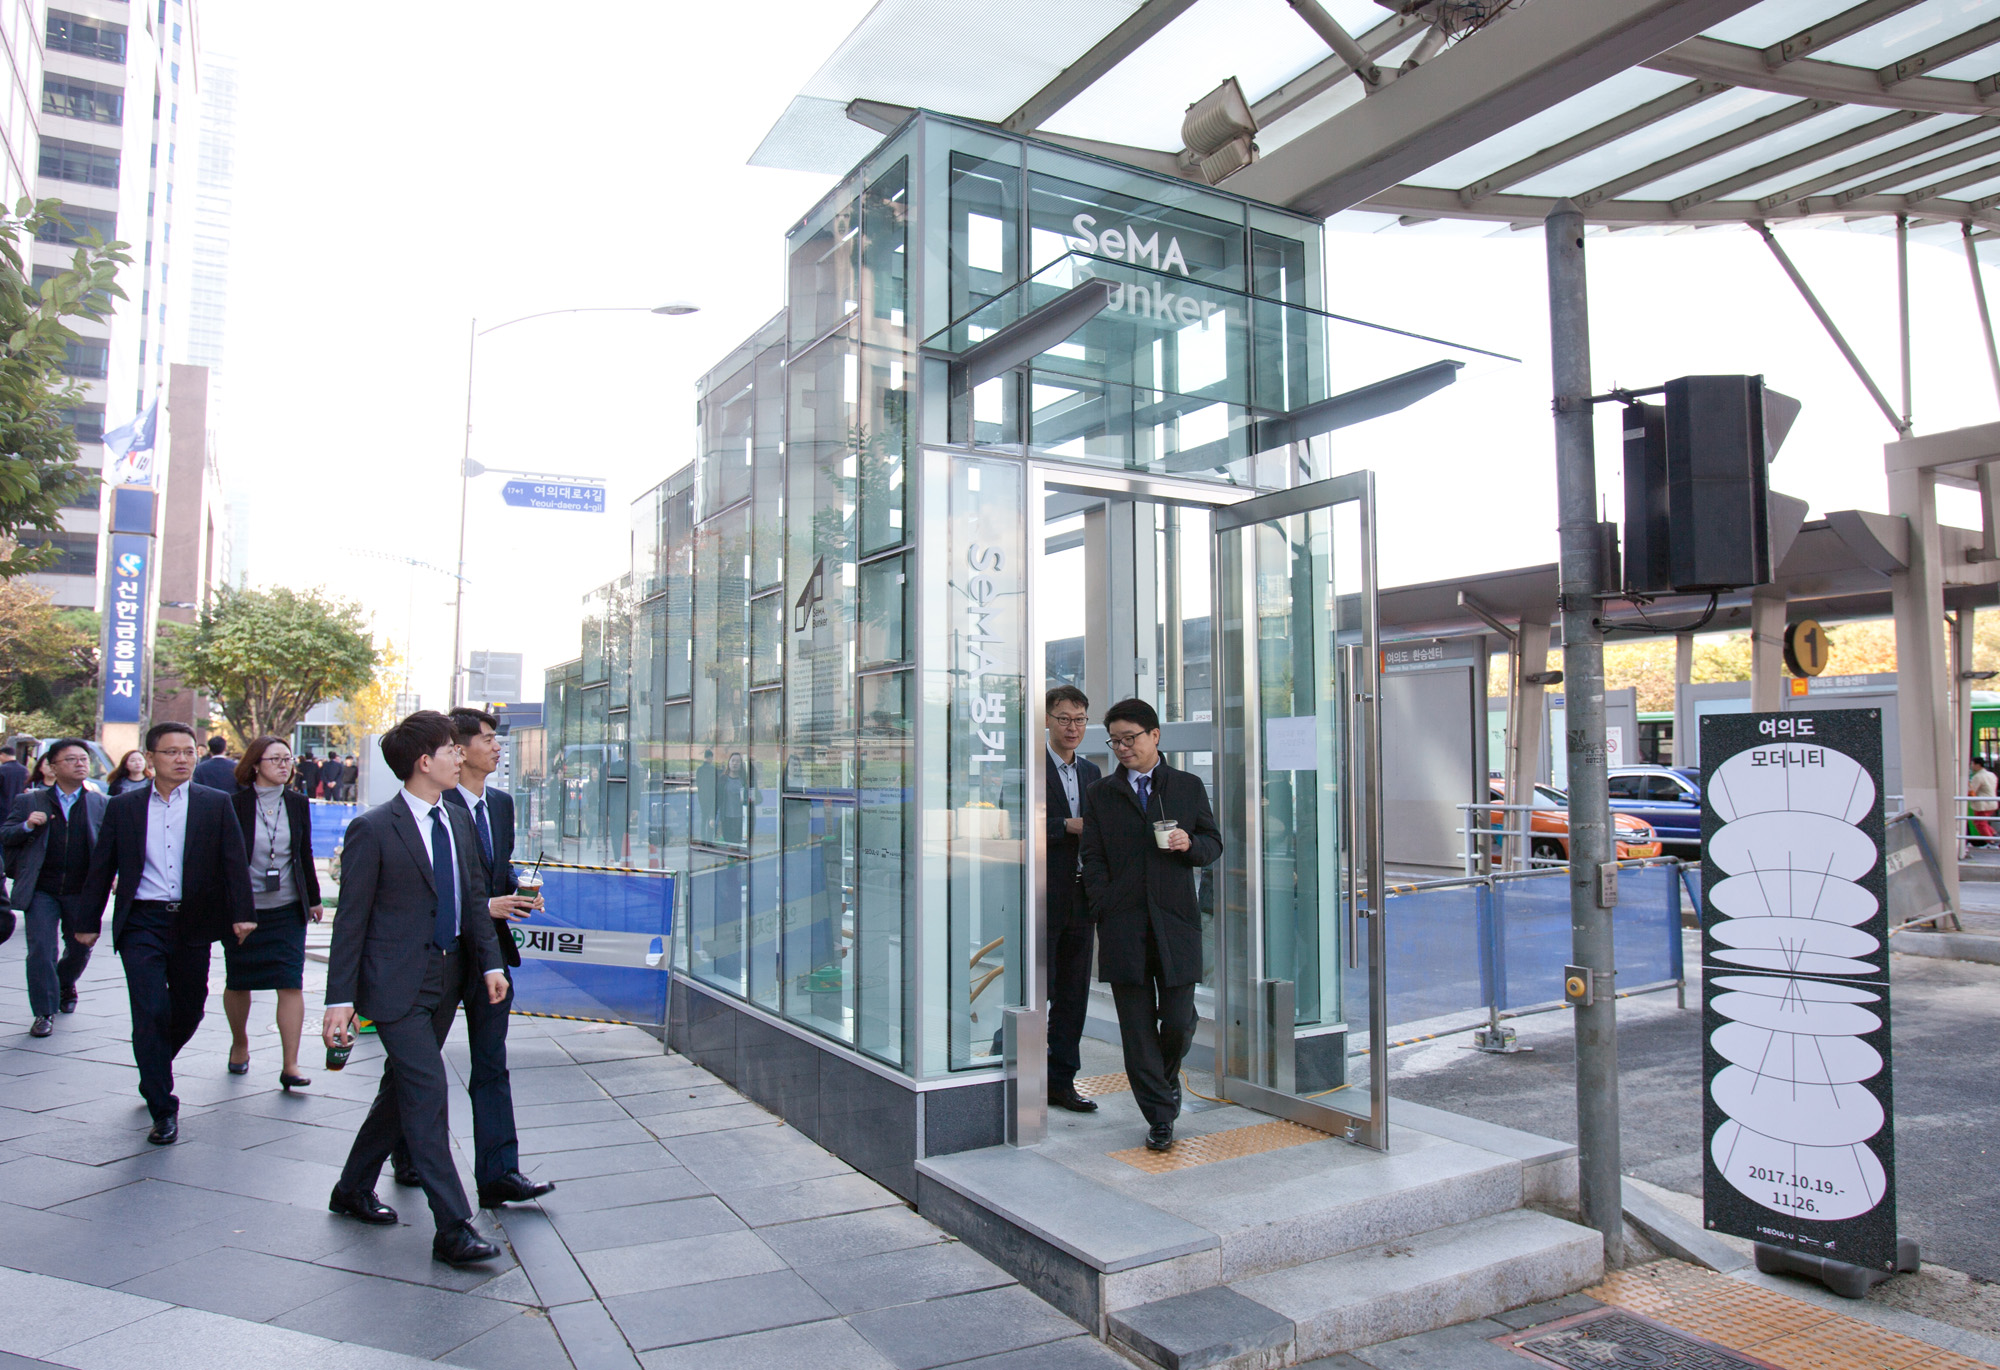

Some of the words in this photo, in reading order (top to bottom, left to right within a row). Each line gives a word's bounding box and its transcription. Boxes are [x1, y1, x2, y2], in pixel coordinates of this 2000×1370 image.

[1072, 213, 1190, 276] SeMA
[534, 485, 602, 502] 여의대로4길
[530, 499, 581, 510] Yeoui-daero
[583, 502, 602, 513] 4-gil
[969, 543, 1006, 680] SeMA
[112, 581, 139, 698] 신한금융투자
[1804, 627, 1818, 668] 1
[1386, 651, 1408, 663] 여의도
[1413, 647, 1443, 661] 환승센터
[971, 693, 1006, 762] 벙커
[1758, 718, 1816, 738] 여의도
[1751, 749, 1825, 768] 모더니티
[526, 931, 585, 954] 제일
[1772, 1192, 1820, 1214] 11.26.
